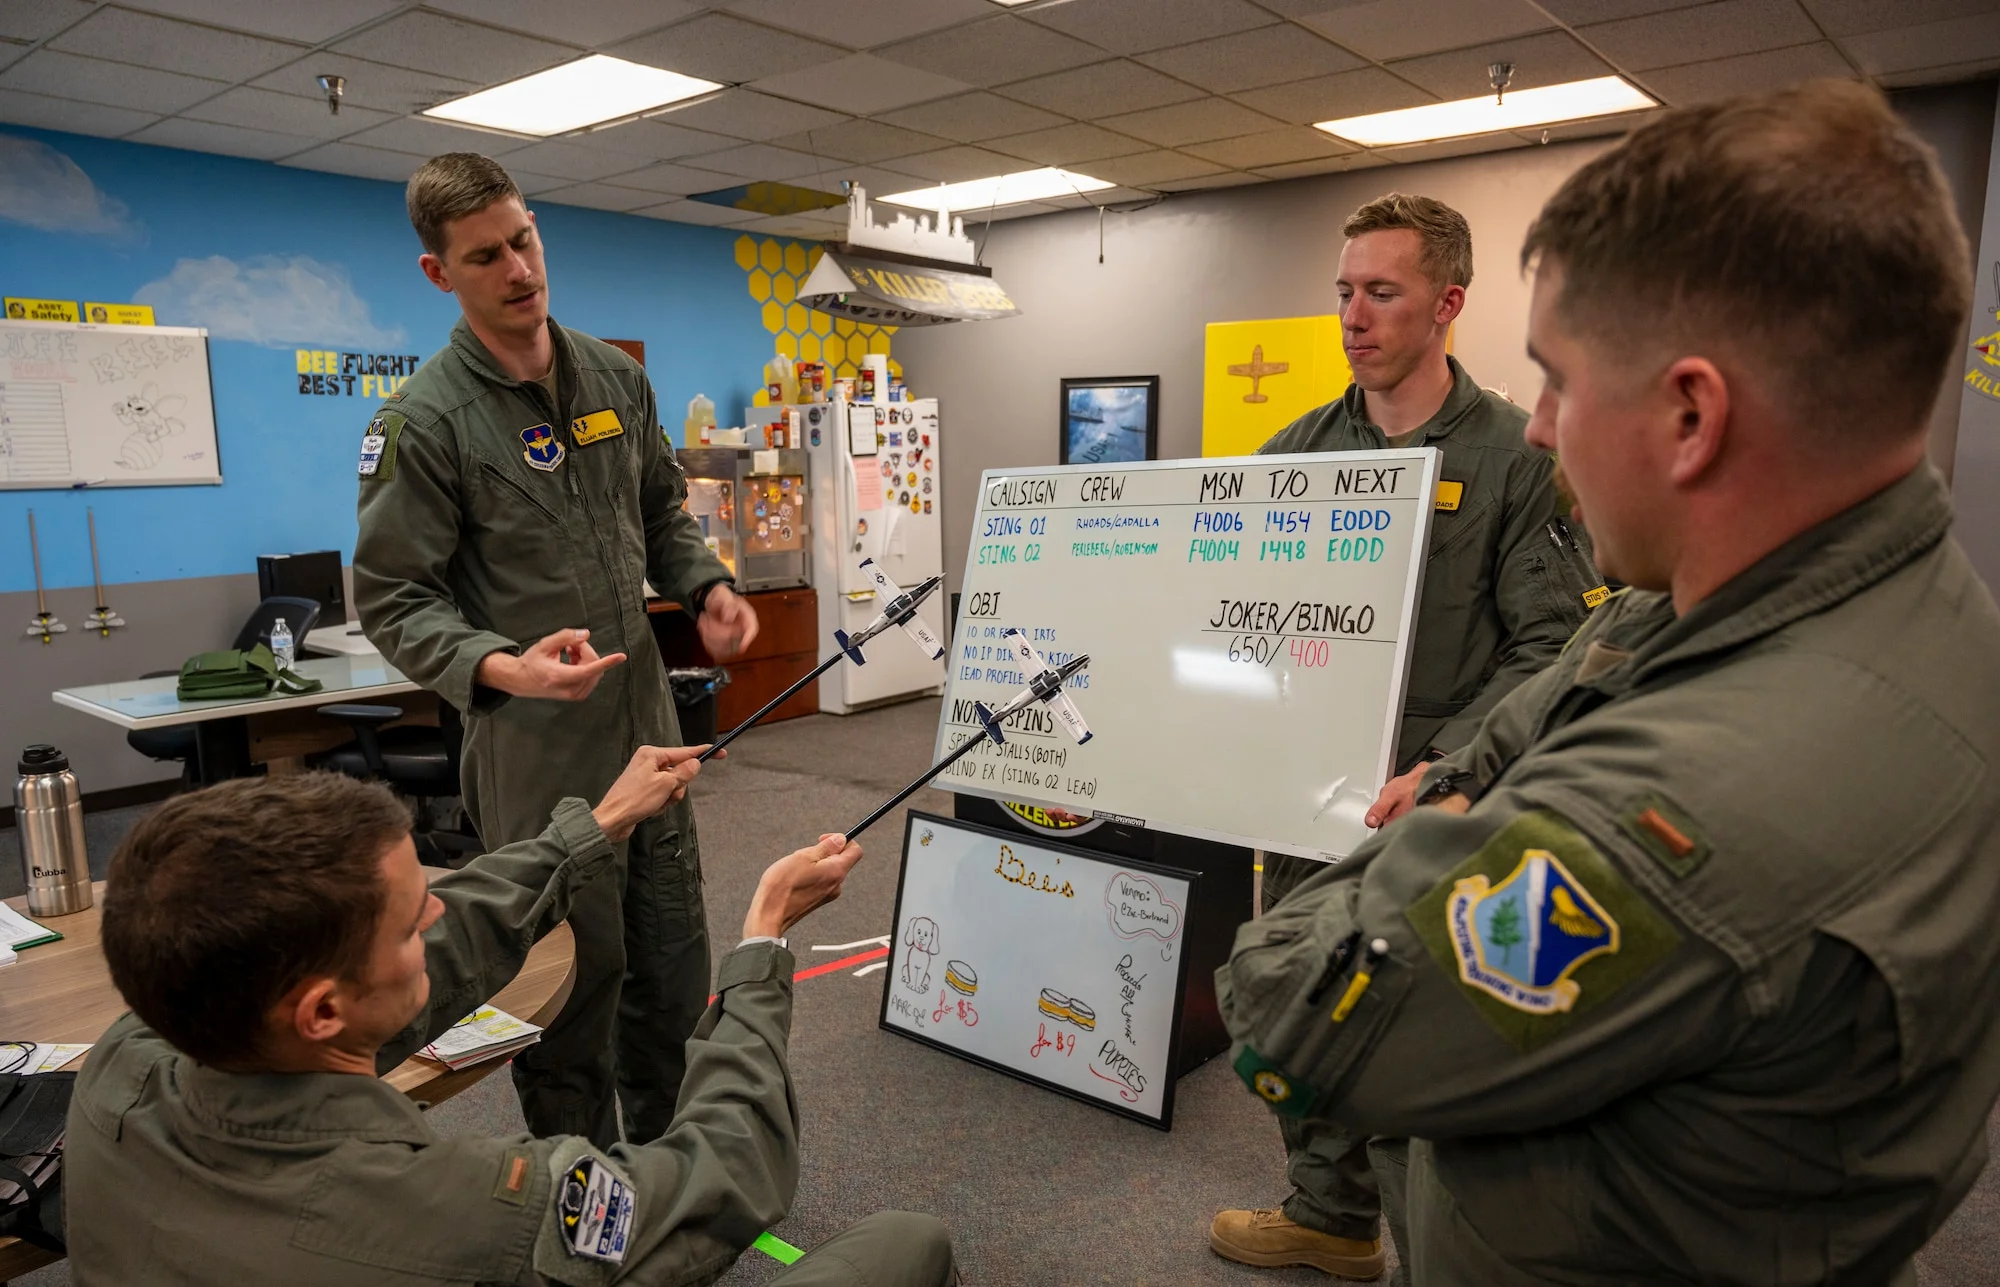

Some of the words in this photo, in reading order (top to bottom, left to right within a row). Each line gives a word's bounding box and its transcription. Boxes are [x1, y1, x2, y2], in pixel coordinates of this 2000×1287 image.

[866, 267, 953, 305] KILLER
[31, 309, 73, 323] Safety
[296, 349, 339, 375] BEE
[342, 352, 420, 377] FLIGHT
[299, 374, 357, 397] BEST
[990, 479, 1058, 507] CALLSIGN
[1080, 475, 1126, 502] CREW
[1199, 471, 1244, 503] MSN
[1268, 468, 1309, 500] T/O
[1334, 467, 1406, 496] NEXT
[1436, 501, 1454, 509] OADS
[983, 516, 1022, 537] STING
[1029, 515, 1047, 536] 01
[1193, 511, 1244, 533] F4006
[1265, 510, 1311, 533] 1454
[1331, 509, 1391, 532] EODD
[978, 543, 1017, 565] STING
[1024, 543, 1041, 563] 02
[1188, 539, 1240, 563] F4004
[1259, 539, 1306, 562] 1448
[1327, 537, 1385, 562] EODD
[969, 591, 1001, 616] OBJ
[1210, 600, 1375, 635] JOKER/BINGO
[918, 629, 935, 643] USAF
[984, 627, 996, 639] OR
[963, 645, 978, 660] NO
[981, 646, 992, 660] IP
[960, 666, 982, 681] LEAD
[985, 668, 1025, 685] PROFILE
[1062, 710, 1077, 726] USAF
[996, 741, 1030, 761] STALLS
[982, 763, 996, 781] EX
[1002, 763, 1040, 786] (STING
[1045, 774, 1059, 790] 02
[1067, 777, 1098, 800] LEAD)
[32, 865, 67, 879] bubba
[1120, 880, 1150, 902] Venmo:
[1115, 953, 1148, 991] Proceeds
[957, 999, 979, 1027] $5
[1056, 1031, 1077, 1057] $9
[1098, 1038, 1149, 1093] PUPPIES
